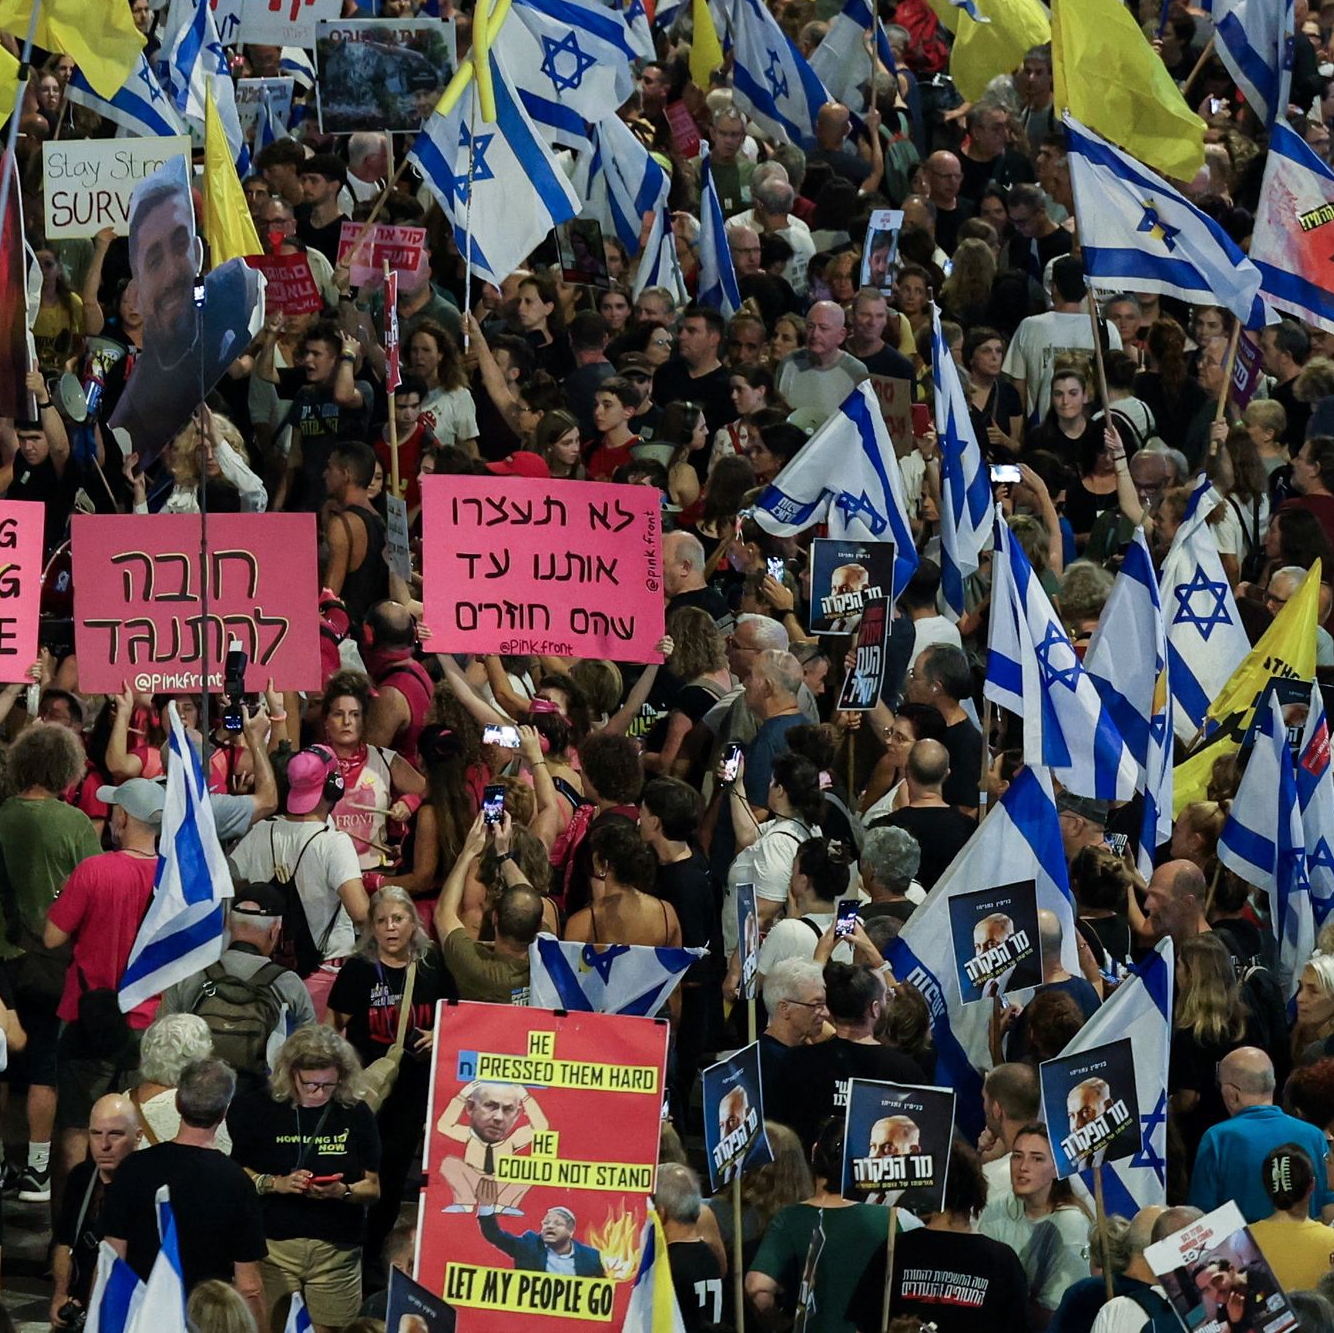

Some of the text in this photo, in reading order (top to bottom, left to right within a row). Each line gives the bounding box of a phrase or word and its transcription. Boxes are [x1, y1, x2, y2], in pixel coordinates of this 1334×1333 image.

[48, 152, 101, 188] Stay
[400, 230, 424, 246] קול
[452, 495, 635, 533] לא תעצרו
[111, 549, 259, 602] חובה
[456, 548, 620, 586] אותנו עד
[820, 585, 883, 616] מר הפקרה
[455, 599, 634, 641] שהם חוזרים
[83, 606, 290, 667] להתנגד
[856, 645, 881, 677] העם
[337, 813, 374, 827] FRONT
[963, 929, 1031, 982] מר הפקרה
[529, 1034, 551, 1055] HE
[479, 1056, 554, 1082] PRESSED
[560, 1063, 604, 1087] THEM
[609, 1066, 654, 1090] HARD
[881, 1099, 924, 1114] בנימין נתניהו
[276, 1135, 300, 1144] HOW
[533, 1134, 554, 1155] HE
[1060, 1099, 1130, 1160] מר הפקרה
[318, 1143, 346, 1152] NOW
[712, 1123, 748, 1169] הפקרה
[498, 1158, 652, 1189] COULD NOT STAND
[853, 1155, 934, 1183] מר הפקרה
[446, 1265, 613, 1316] LET MY PEOPLE GO
[901, 1281, 985, 1306] החטופים והנעדרים
[934, 1272, 972, 1289] המשפחות
[973, 1277, 989, 1291] מטה
[693, 1277, 723, 1324] די
